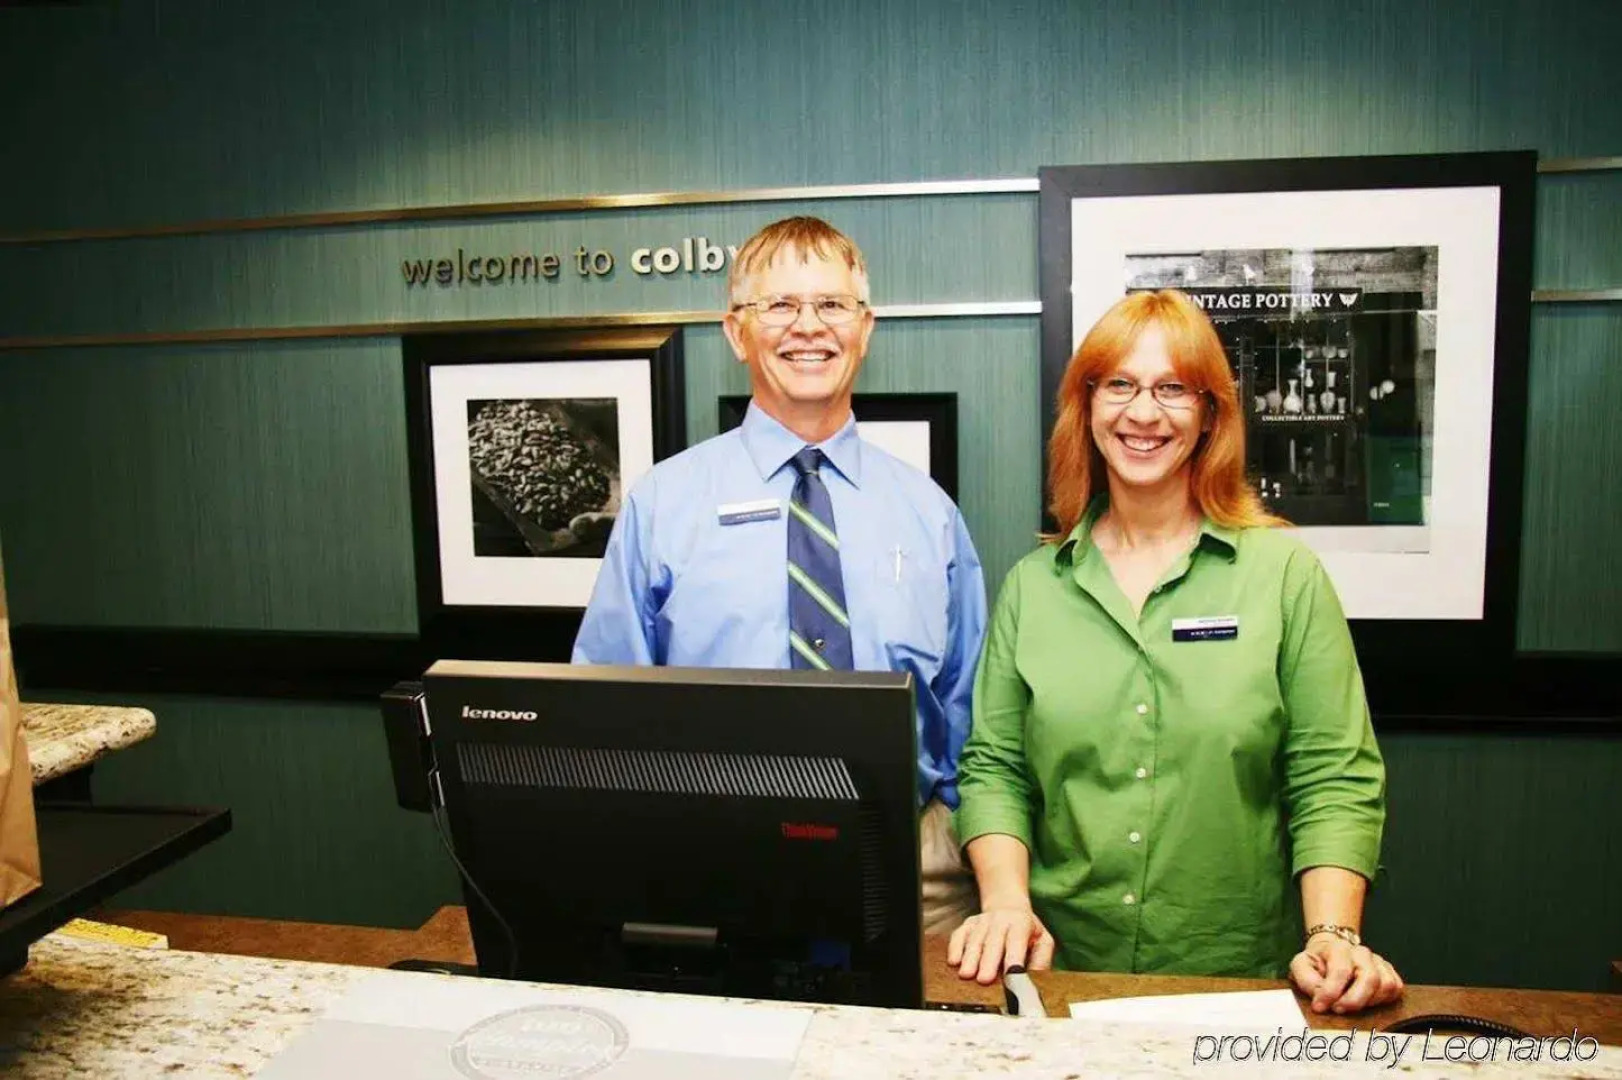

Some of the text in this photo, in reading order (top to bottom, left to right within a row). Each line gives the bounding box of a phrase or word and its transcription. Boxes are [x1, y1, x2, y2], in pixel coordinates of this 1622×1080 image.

[402, 249, 561, 286] welcome
[576, 245, 614, 276] to
[1255, 292, 1333, 310] POTTERY
[462, 705, 538, 721] lenovo
